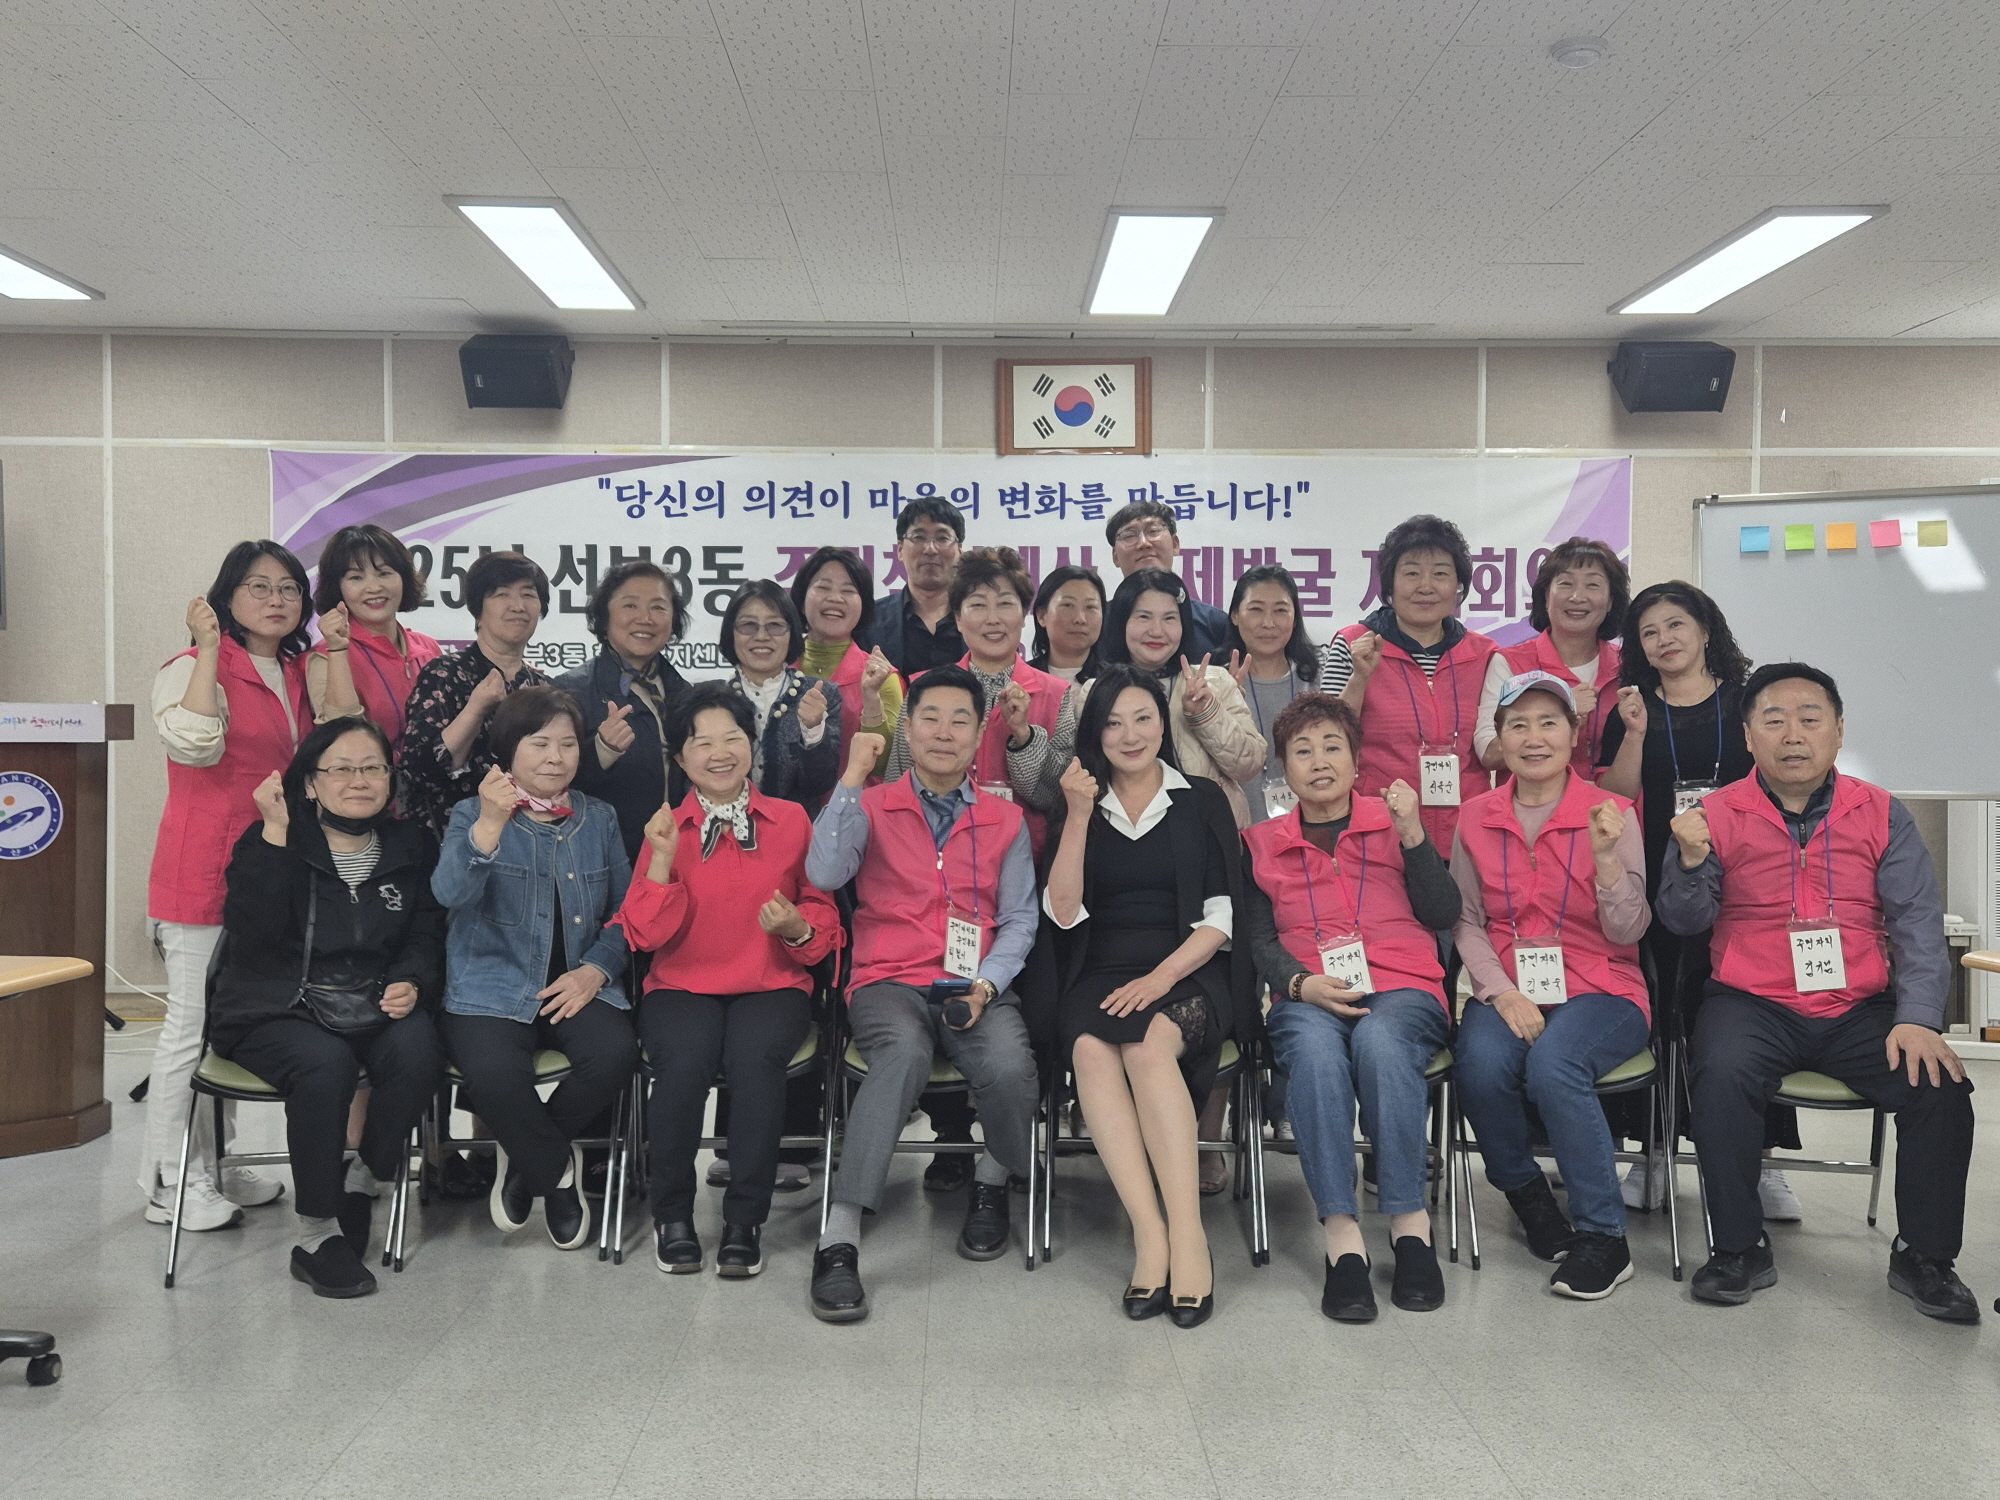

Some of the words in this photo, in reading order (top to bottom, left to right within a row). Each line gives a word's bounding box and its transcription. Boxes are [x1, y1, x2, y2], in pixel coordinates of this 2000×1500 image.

[598, 477, 725, 519] "당신의
[742, 479, 850, 519] 의견이
[998, 481, 1112, 519] 변화를
[24, 776, 53, 796] CITY
